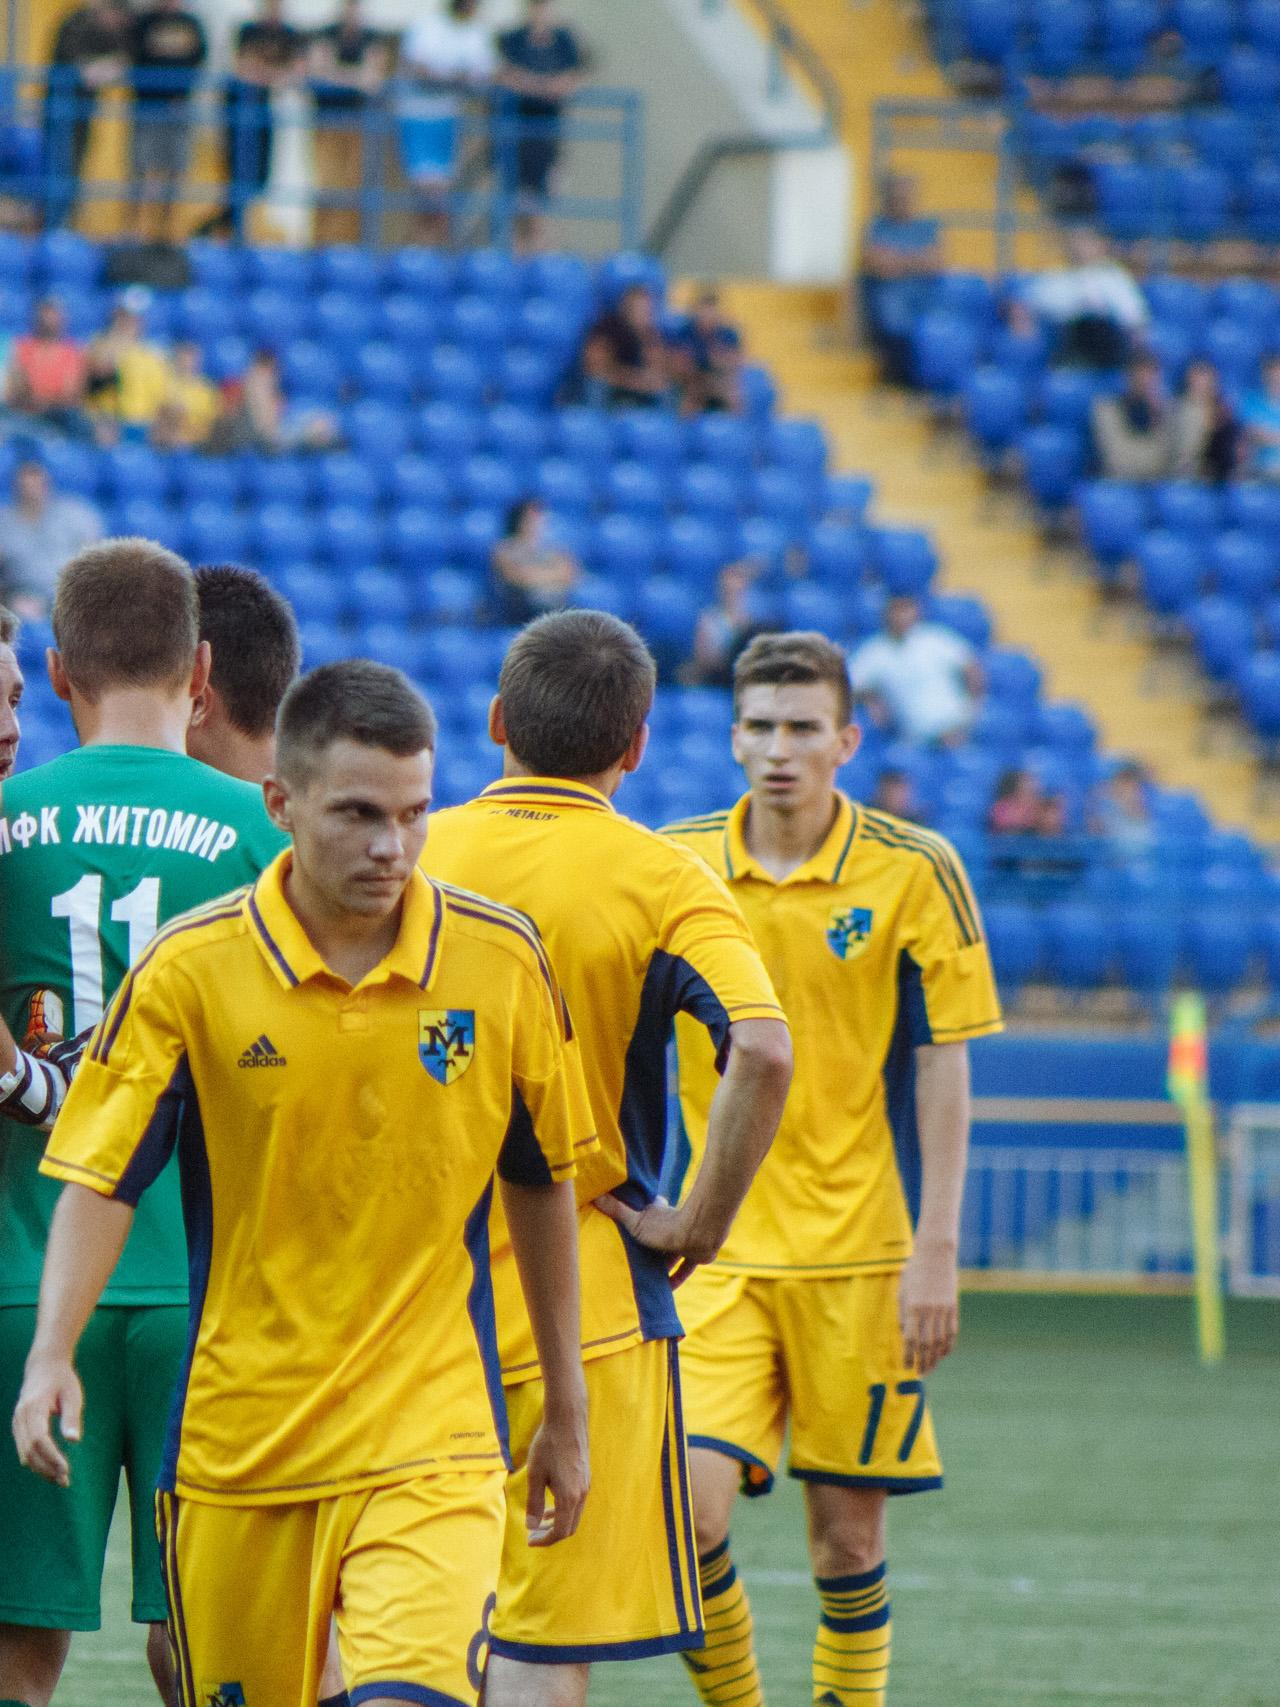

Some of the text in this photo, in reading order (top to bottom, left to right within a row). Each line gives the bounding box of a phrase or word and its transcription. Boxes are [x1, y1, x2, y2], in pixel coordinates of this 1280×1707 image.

[73, 804, 238, 862] ЖИТОМИР
[51, 875, 161, 1037] 11
[237, 1055, 287, 1068] adidas
[859, 1380, 925, 1465] 17
